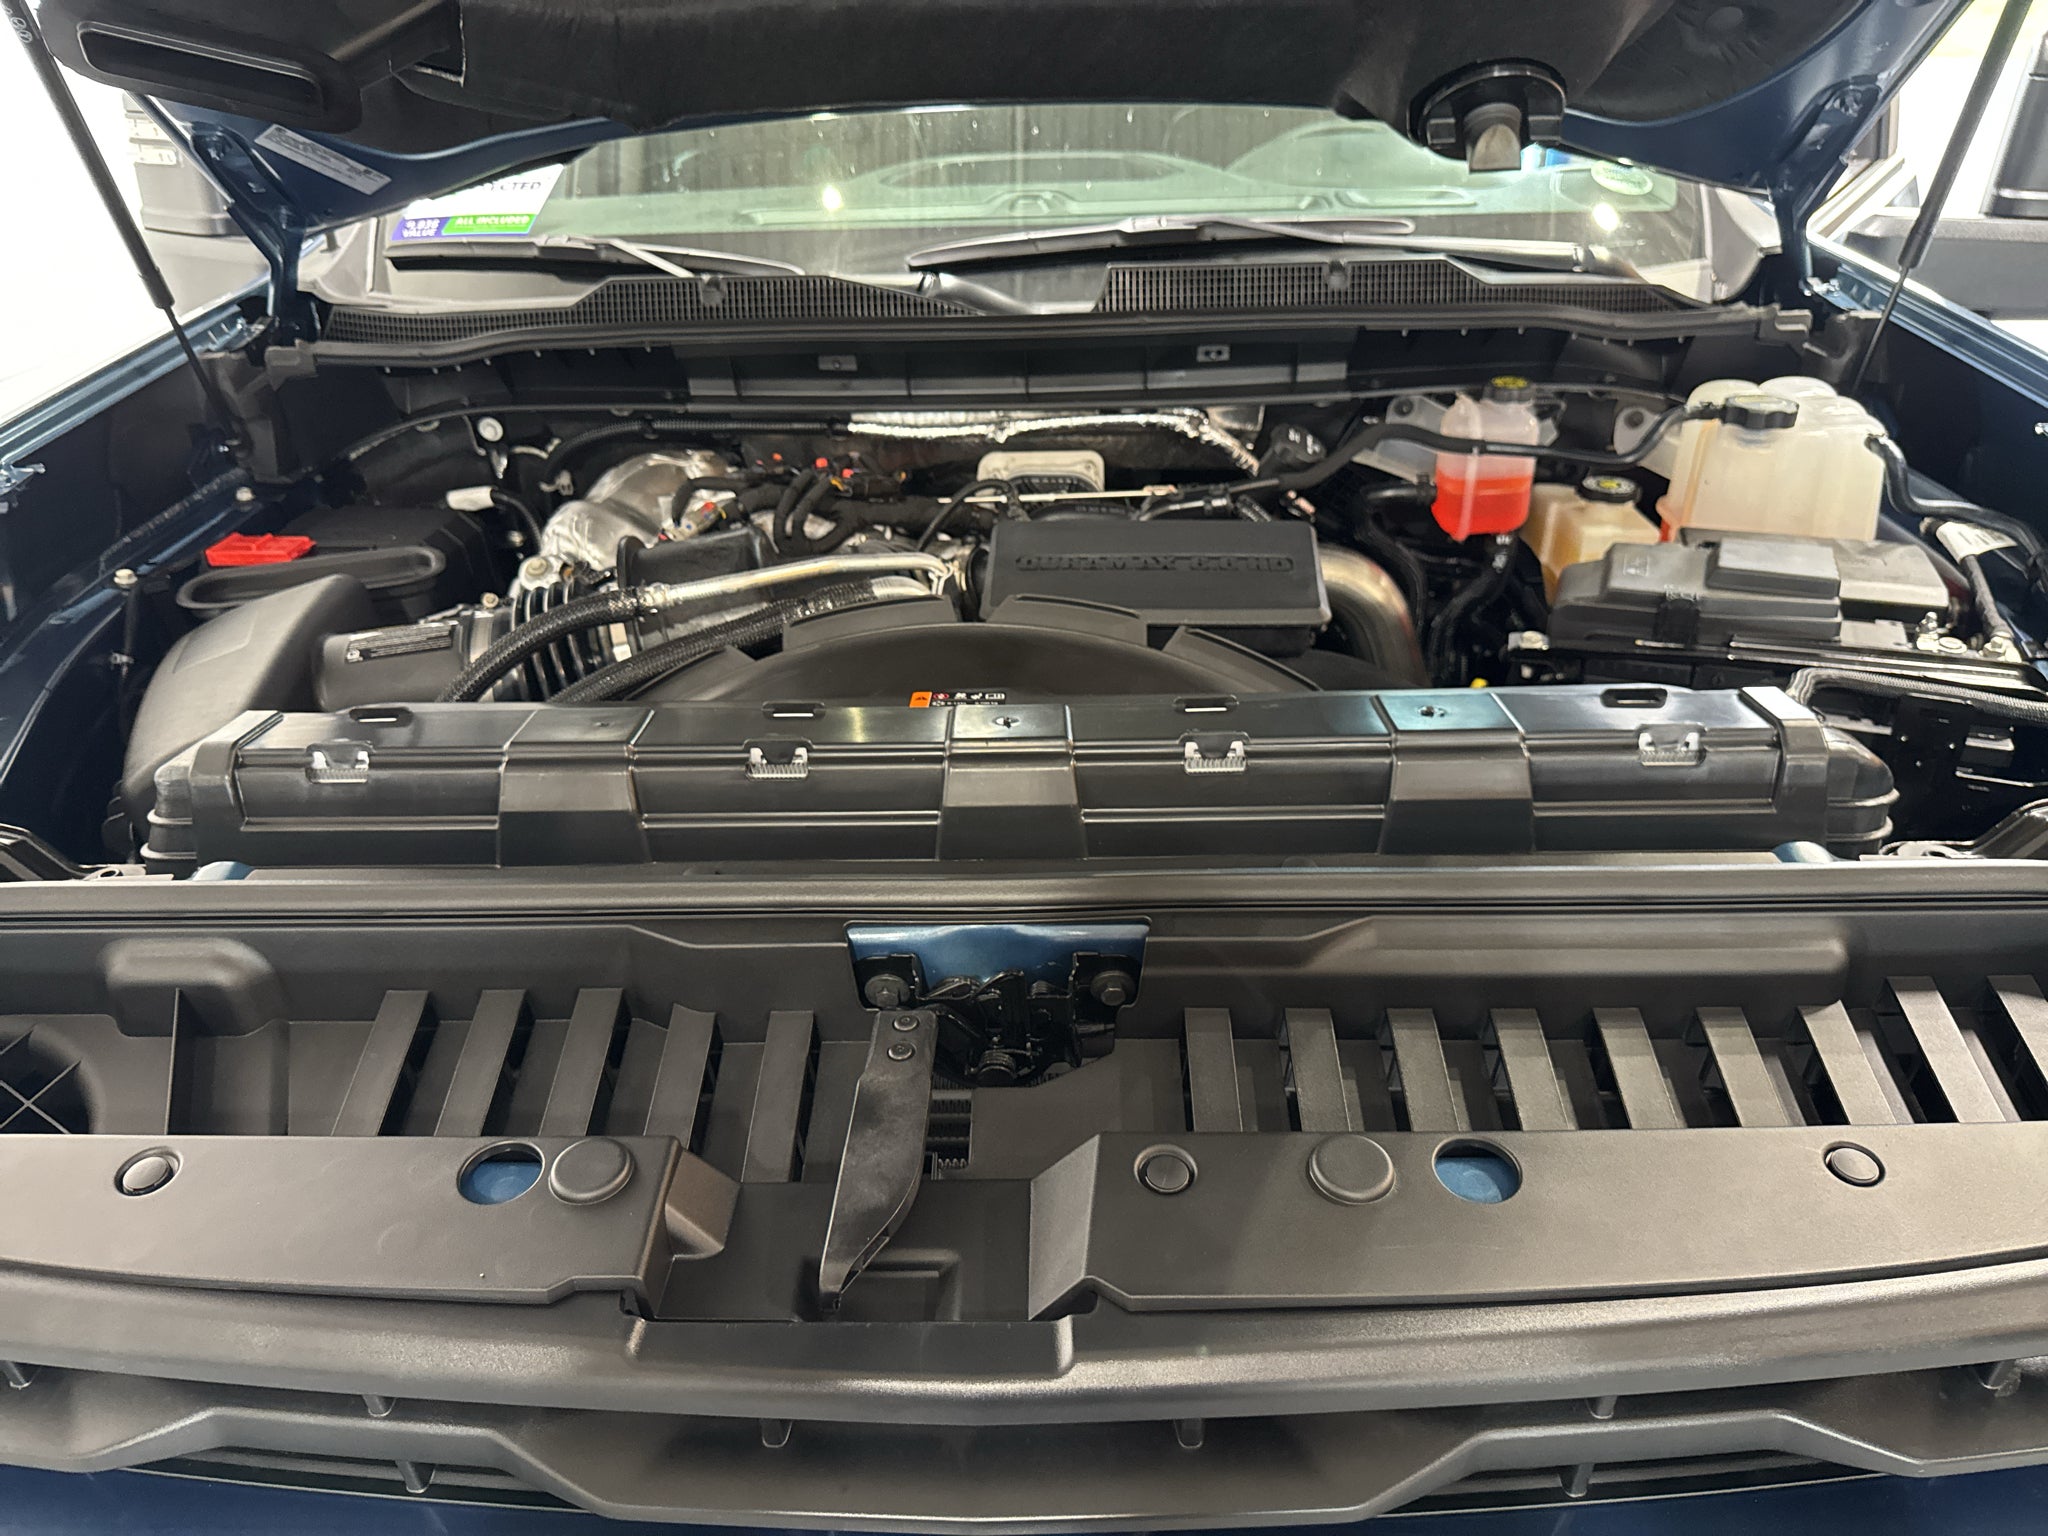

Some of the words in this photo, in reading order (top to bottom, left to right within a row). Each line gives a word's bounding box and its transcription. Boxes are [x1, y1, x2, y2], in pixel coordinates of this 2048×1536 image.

[455, 217, 474, 225] ALL
[476, 215, 530, 225] INCLUDED
[402, 228, 437, 238] VALUE
[1015, 555, 1176, 572] DURAMAX
